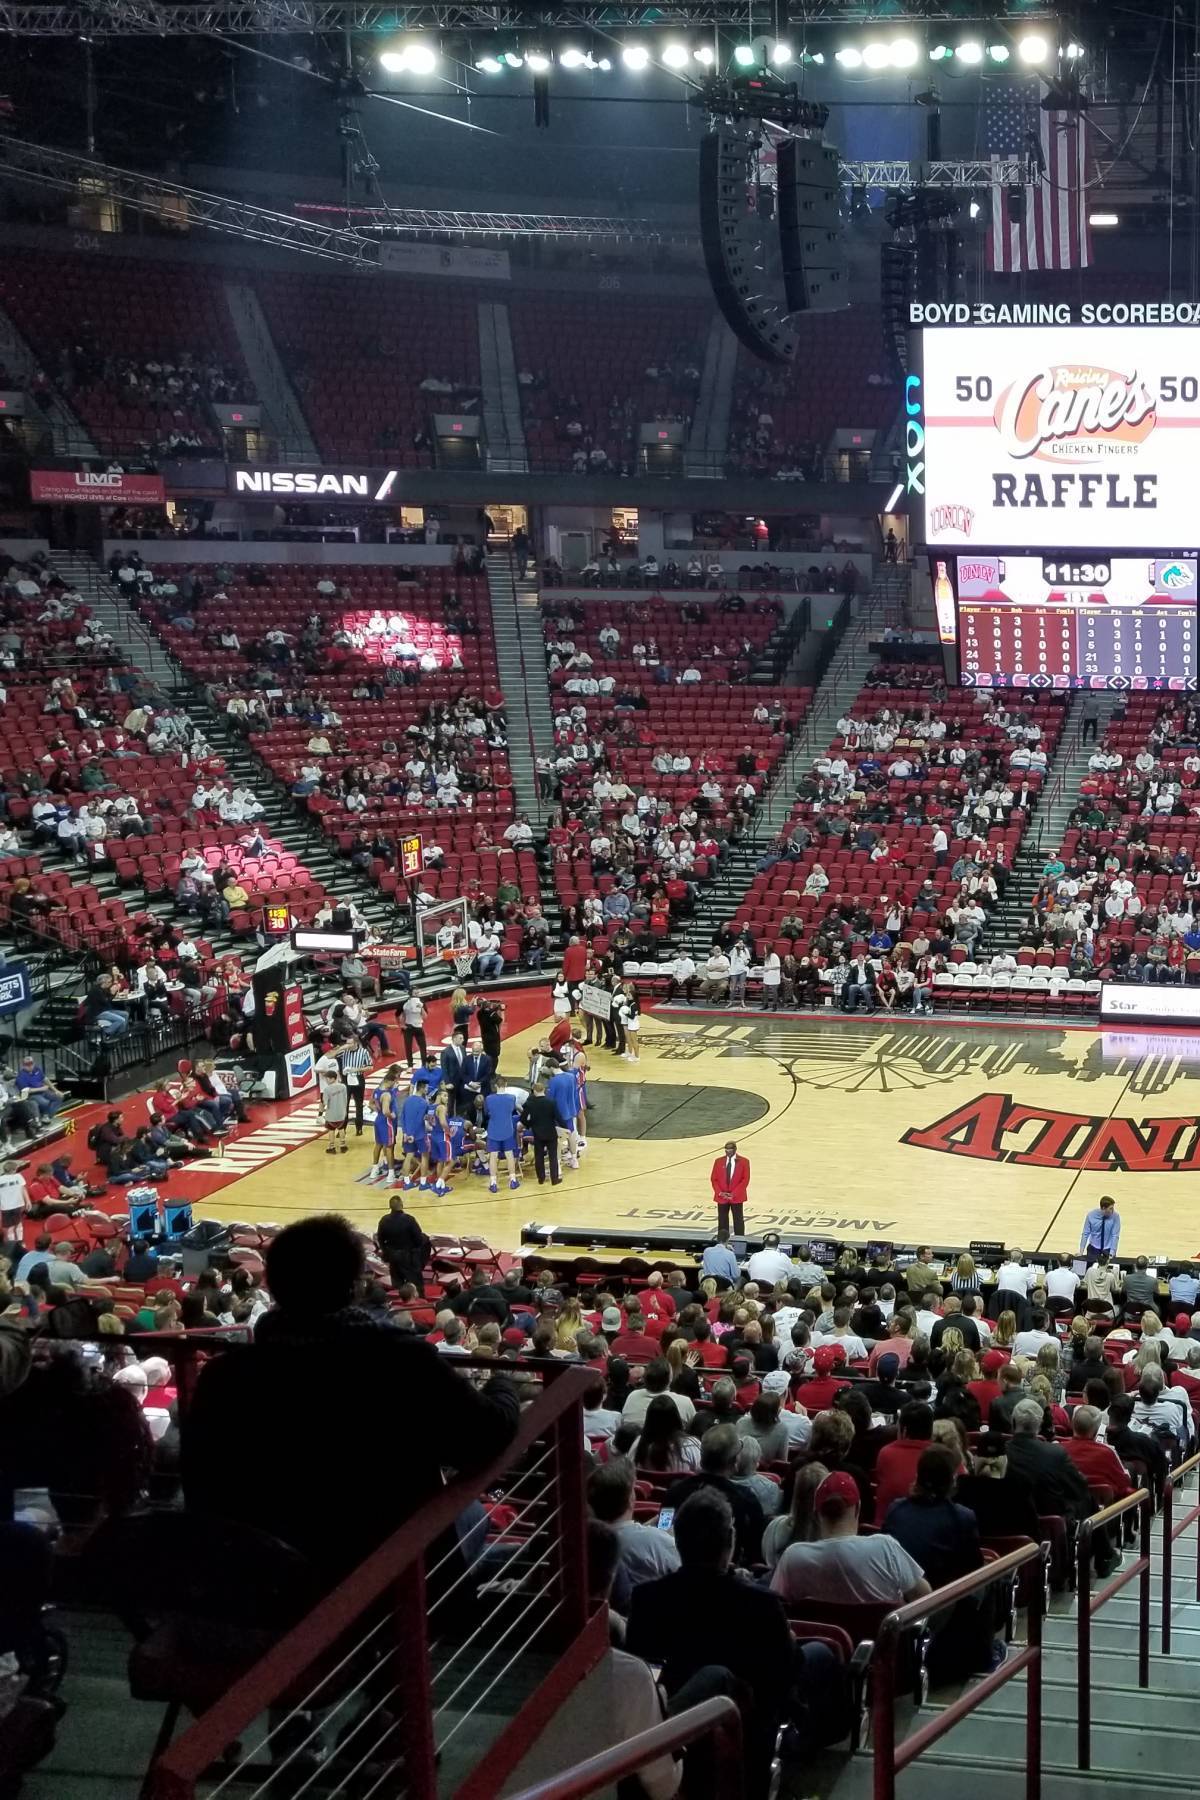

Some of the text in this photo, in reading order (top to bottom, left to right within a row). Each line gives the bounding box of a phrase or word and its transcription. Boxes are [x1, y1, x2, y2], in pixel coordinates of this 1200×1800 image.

[910, 303, 970, 323] BOYD
[980, 303, 1071, 323] GAMING
[956, 376, 1198, 402] 50 50
[905, 374, 925, 494] COX
[236, 471, 368, 494] NISSAN
[992, 473, 1158, 508] RAFFLE
[930, 504, 975, 537] UNLV
[959, 564, 996, 583] UNLV
[1044, 563, 1110, 583] 11:30
[968, 615, 1068, 626] 3 3 3 1 1
[1088, 617, 1190, 628] 0 0 2 0 0
[968, 627, 1069, 638] 5 0 0 1 0
[1088, 629, 1190, 640] 3 3 1 1 0
[966, 638, 1070, 650] 13 0 0 0 0
[1088, 641, 1190, 652] 5 0 0 0 0
[966, 650, 1070, 662] 24 3 2 0 0
[1085, 652, 1190, 664] 21 3 1 1 0
[966, 662, 1070, 673] 30 1 0 0 0
[1085, 664, 1190, 676] 33 0 0 1 1
[271, 918, 285, 929] 30
[288, 1049, 311, 1062] Chevron
